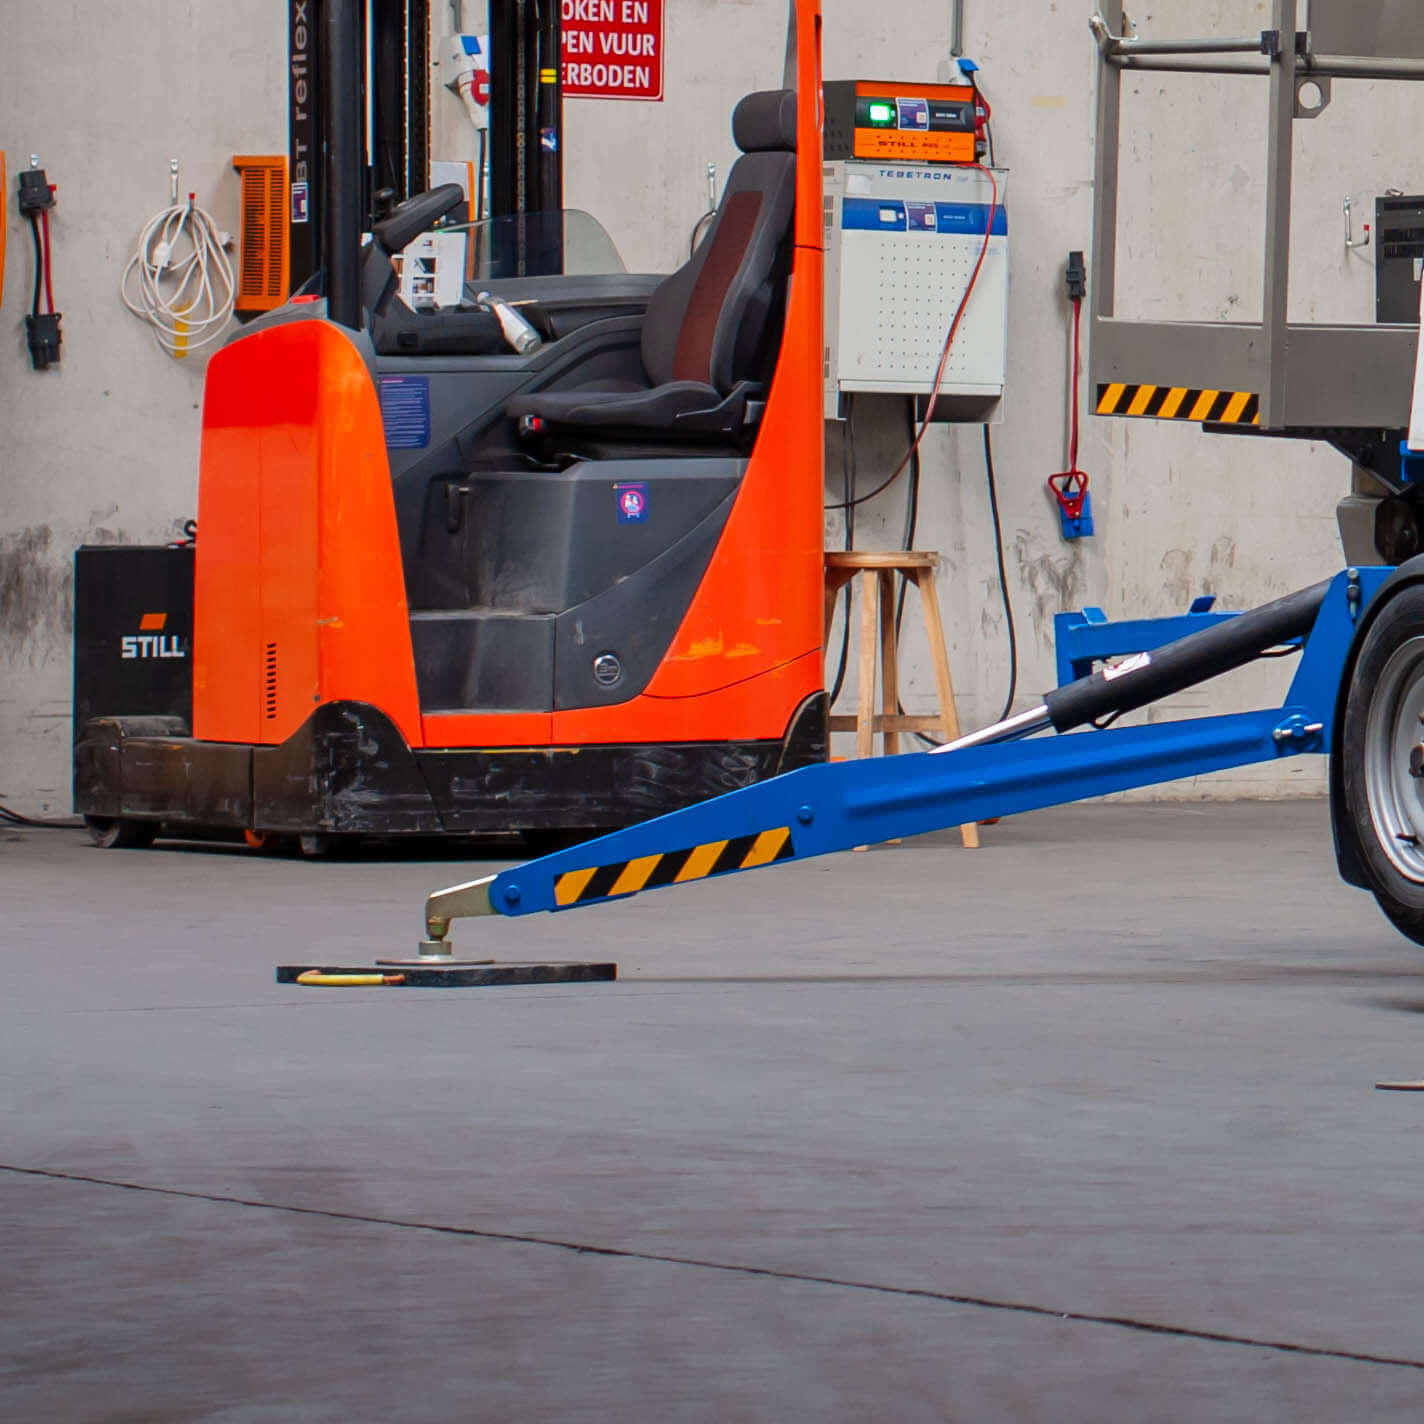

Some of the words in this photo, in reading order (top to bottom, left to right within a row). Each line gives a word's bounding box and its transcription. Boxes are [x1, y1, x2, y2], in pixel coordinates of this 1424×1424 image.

[621, 0, 648, 25] EN
[561, 30, 594, 54] EN
[599, 31, 655, 56] VUUR
[291, 0, 308, 121] reflex
[561, 61, 650, 89] RBODEN
[121, 635, 186, 658] STILL
